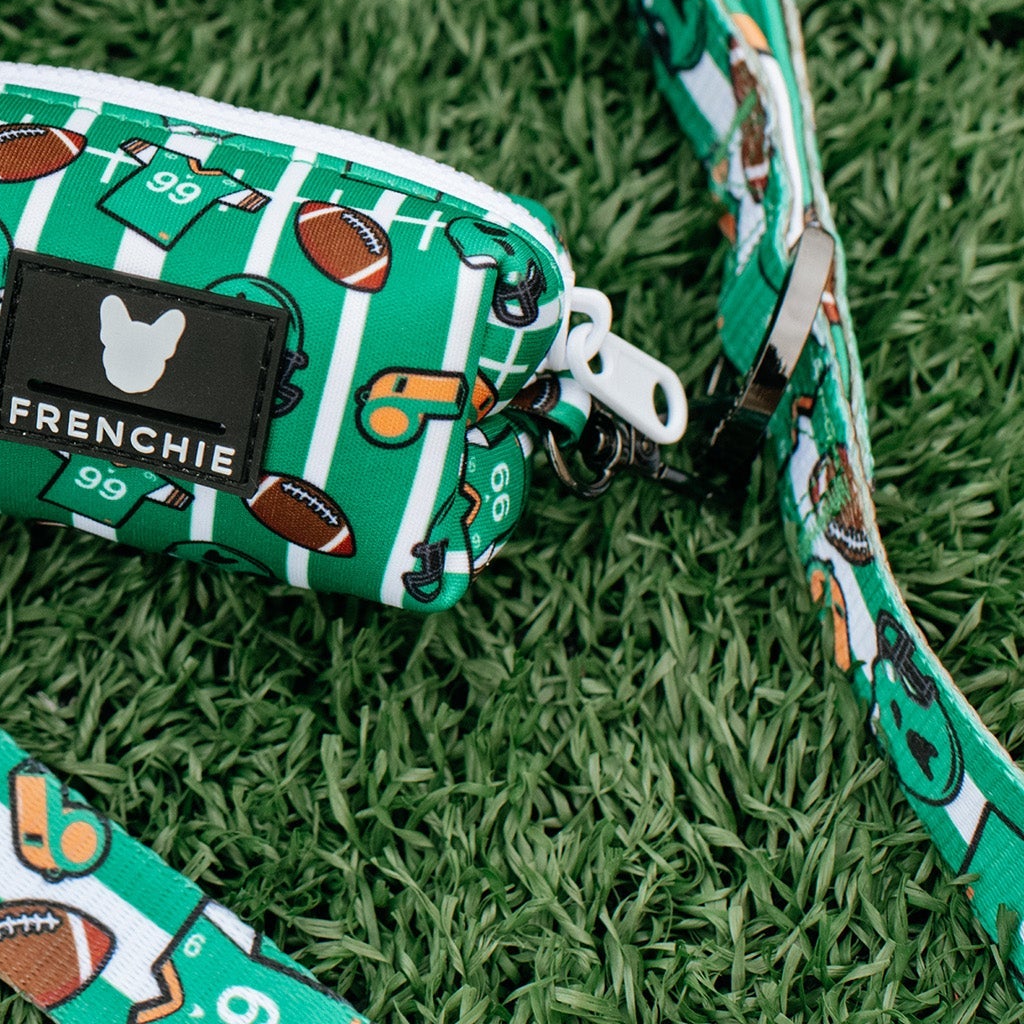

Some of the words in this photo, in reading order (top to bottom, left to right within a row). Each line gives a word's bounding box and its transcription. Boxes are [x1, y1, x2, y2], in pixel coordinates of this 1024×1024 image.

[146, 171, 202, 205] 99
[9, 396, 236, 476] FRENCHIE
[74, 466, 127, 501] 99
